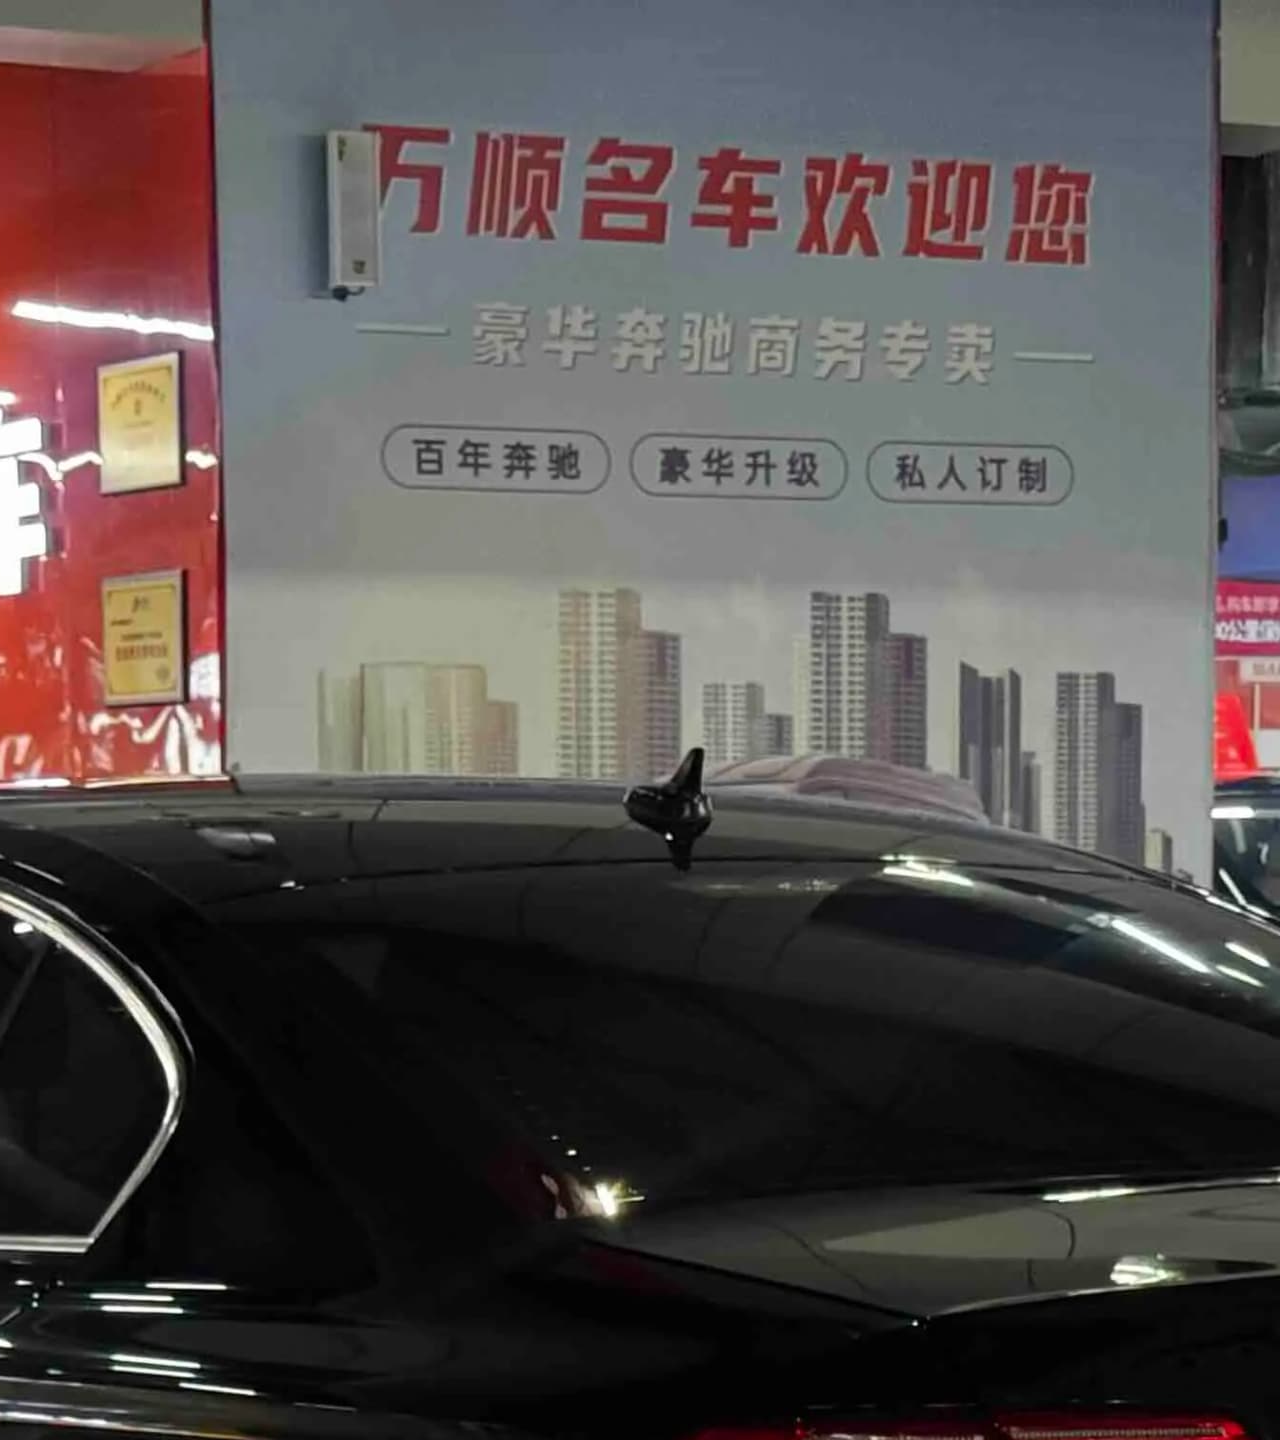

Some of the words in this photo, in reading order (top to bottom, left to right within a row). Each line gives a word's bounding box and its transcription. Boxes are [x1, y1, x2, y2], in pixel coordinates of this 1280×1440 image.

[363, 124, 1094, 266] 万顺名车欢迎您
[471, 302, 998, 385] 豪华奔驰商务专卖
[413, 438, 582, 481] 百年奔驰
[658, 446, 820, 488] 豪华升级
[894, 453, 1048, 494] 私人订制
